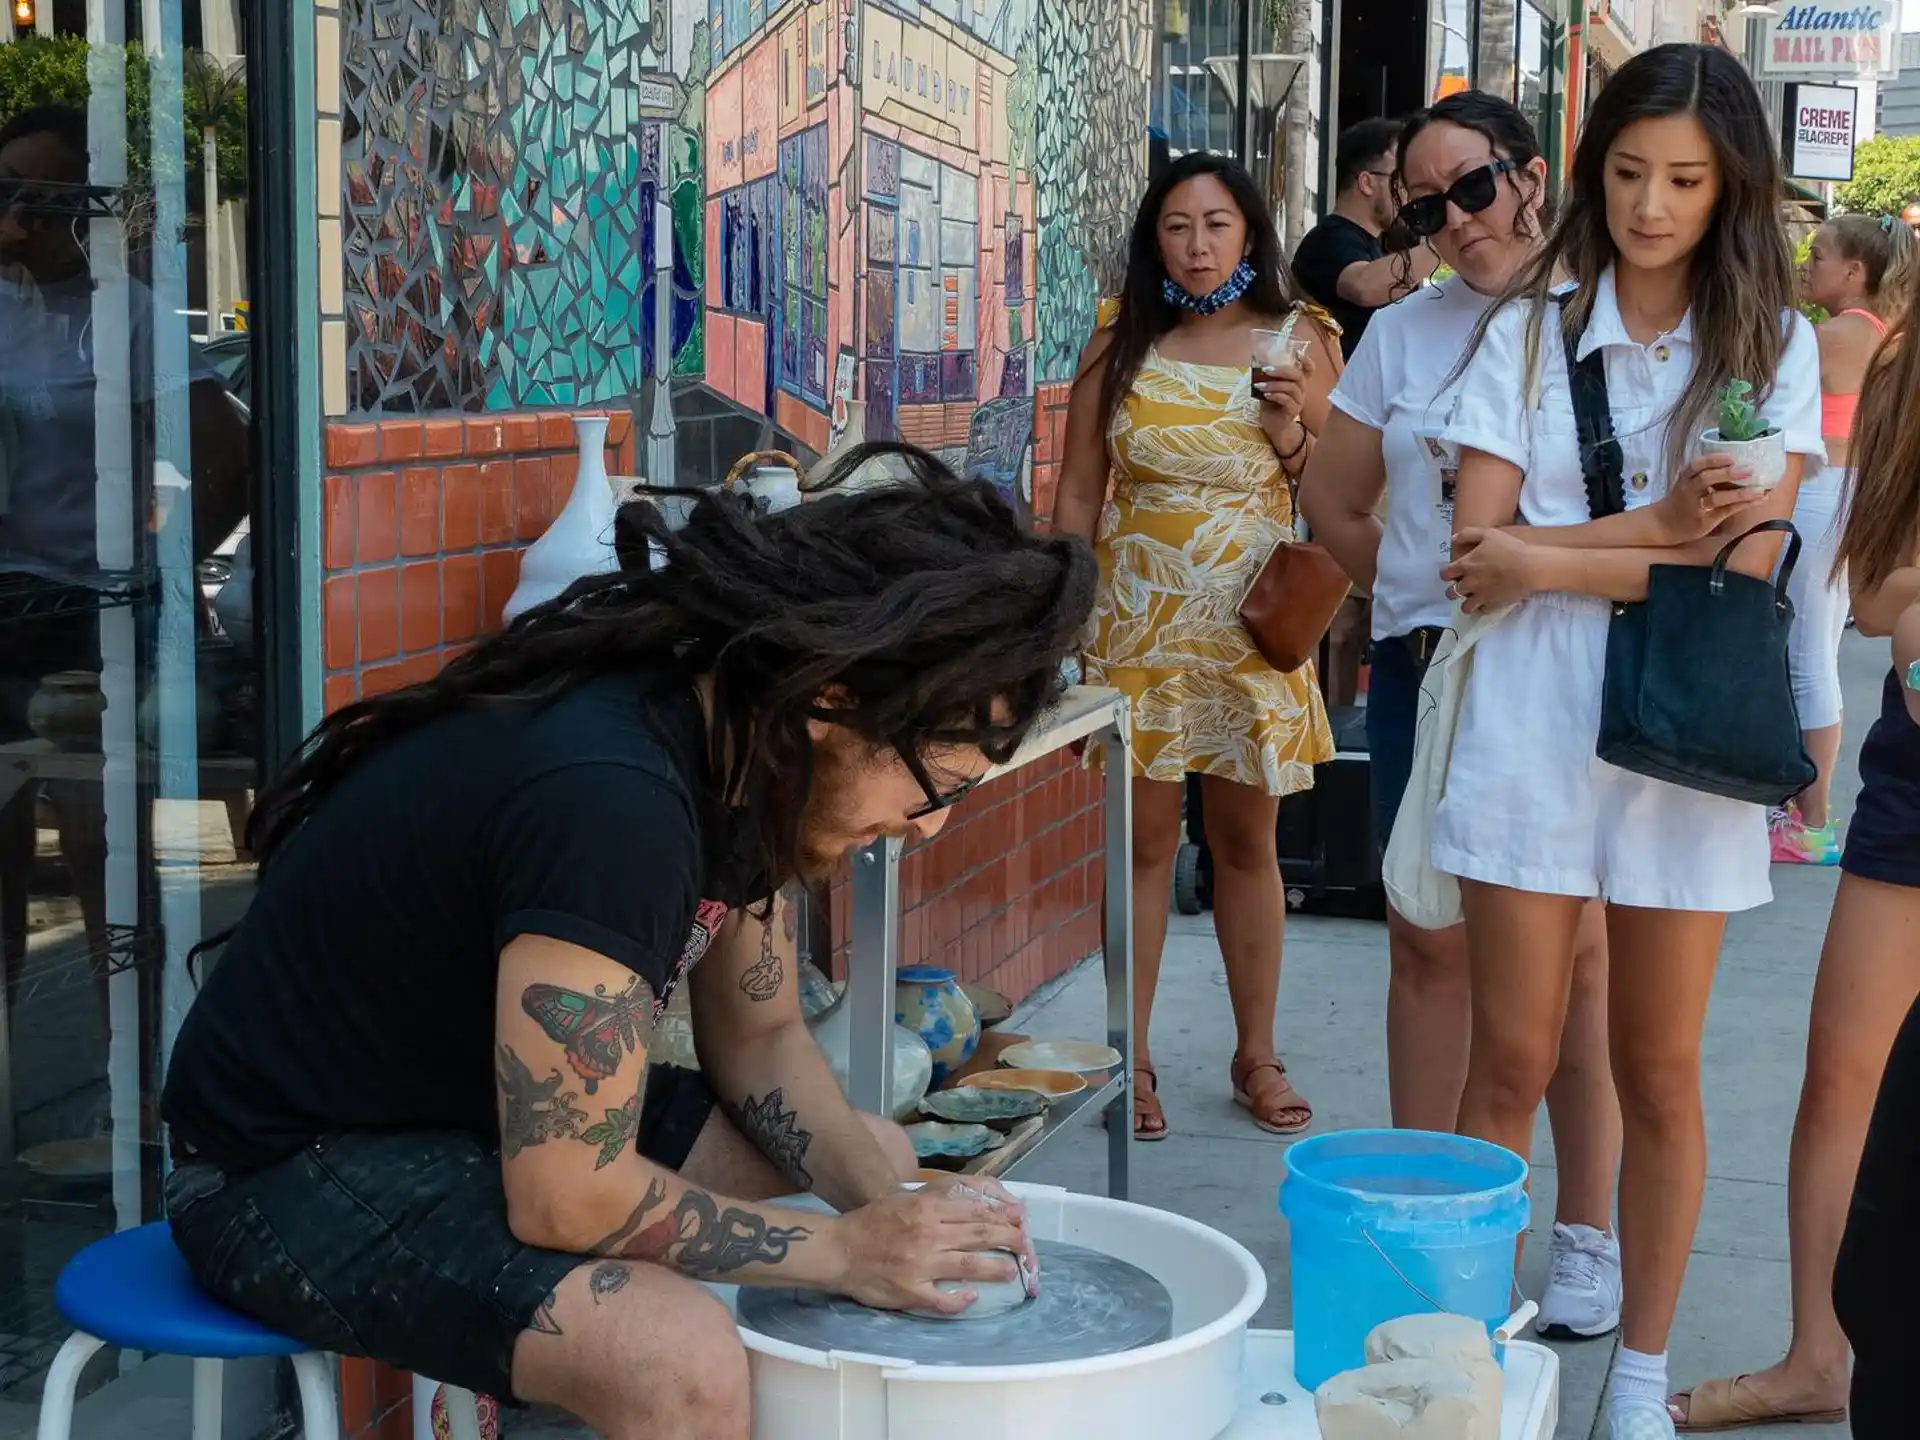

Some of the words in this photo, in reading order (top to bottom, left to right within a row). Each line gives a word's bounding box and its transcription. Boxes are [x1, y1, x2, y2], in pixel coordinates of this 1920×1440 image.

[1776, 5, 1882, 30] Atlantic
[1773, 37, 1825, 62] MAIL
[873, 39, 970, 115] LAUNDRY
[1800, 106, 1851, 130] CREME
